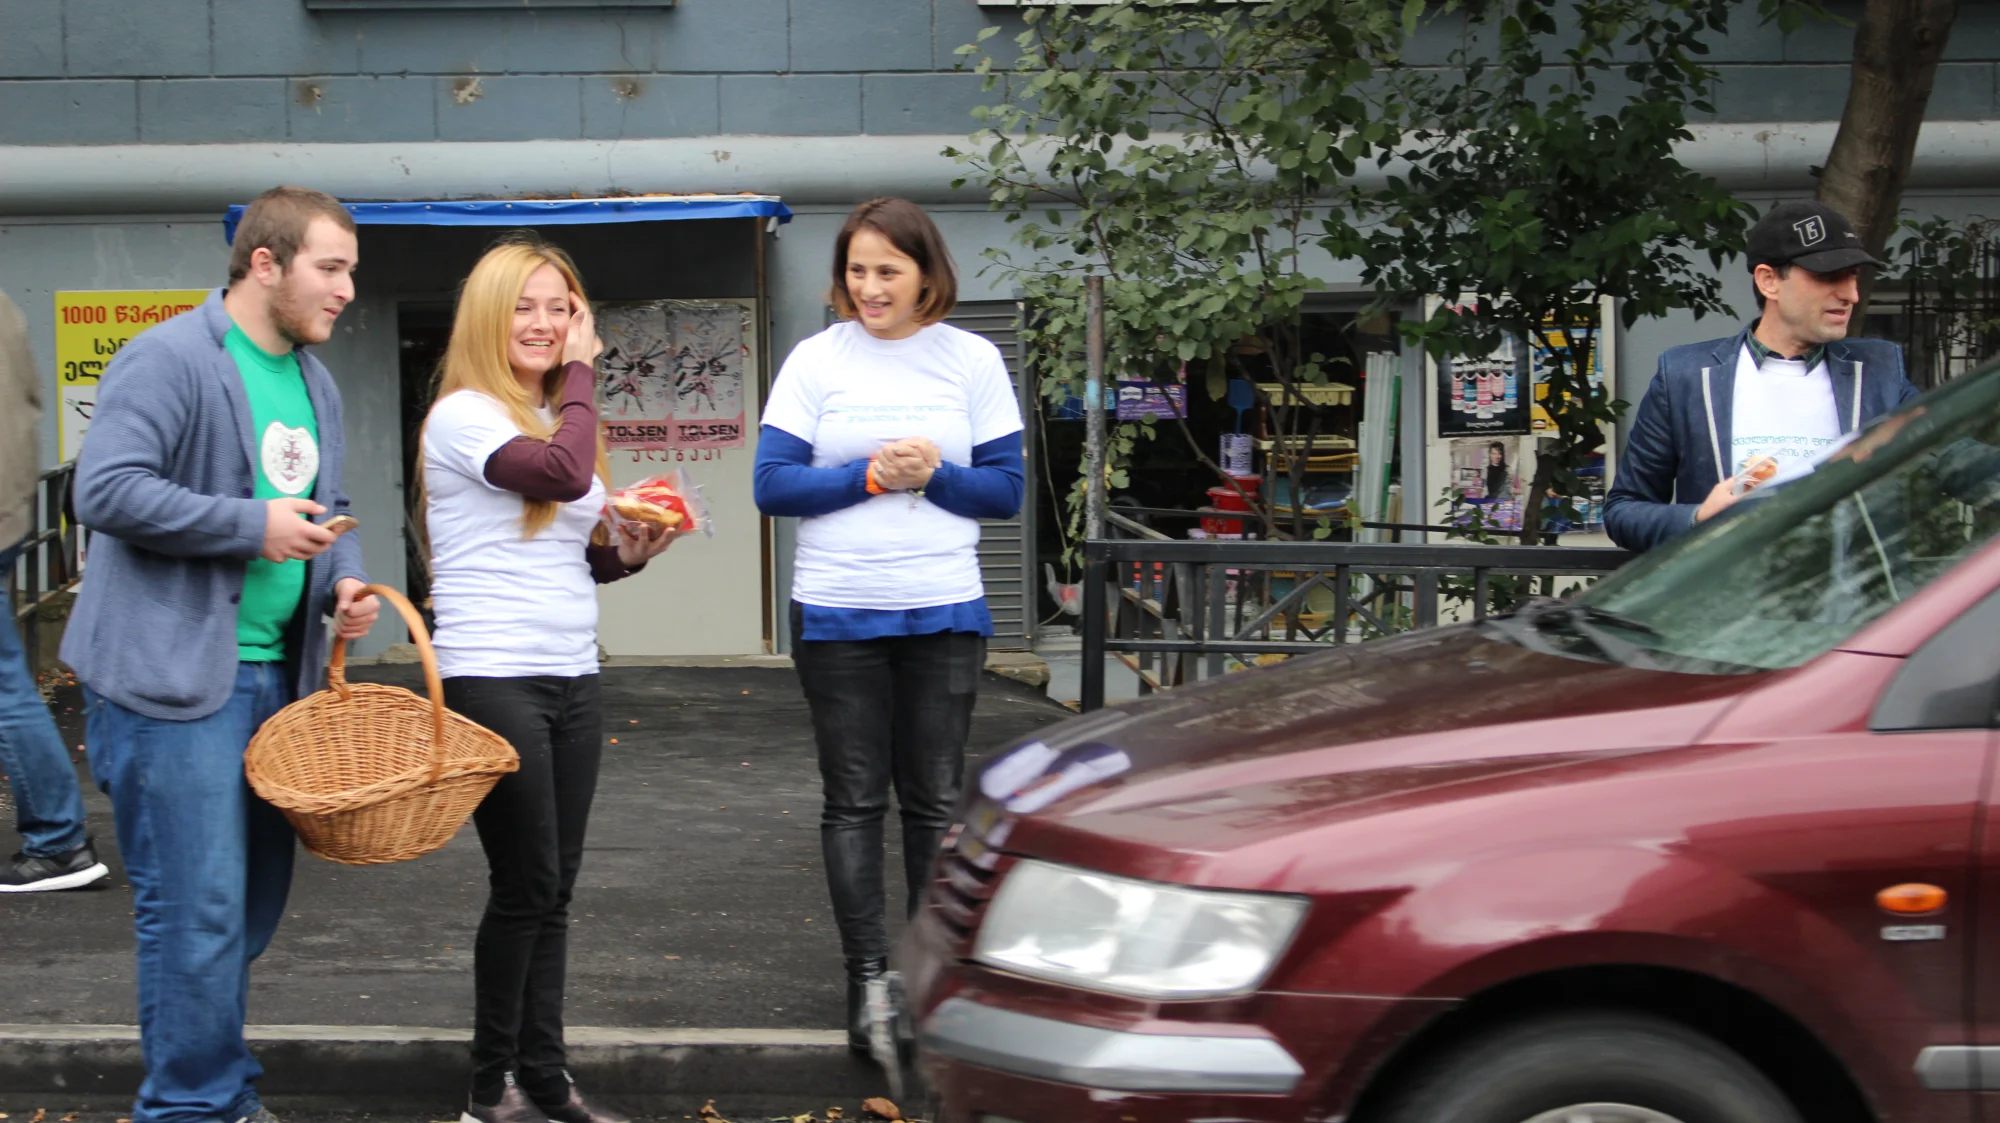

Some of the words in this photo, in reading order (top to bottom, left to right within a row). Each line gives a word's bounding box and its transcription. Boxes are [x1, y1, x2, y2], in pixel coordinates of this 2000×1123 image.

[61, 305, 108, 324] 1000
[65, 361, 110, 381] ელ
[607, 425, 668, 437] TOLSEN
[678, 424, 739, 436] TOLSEN
